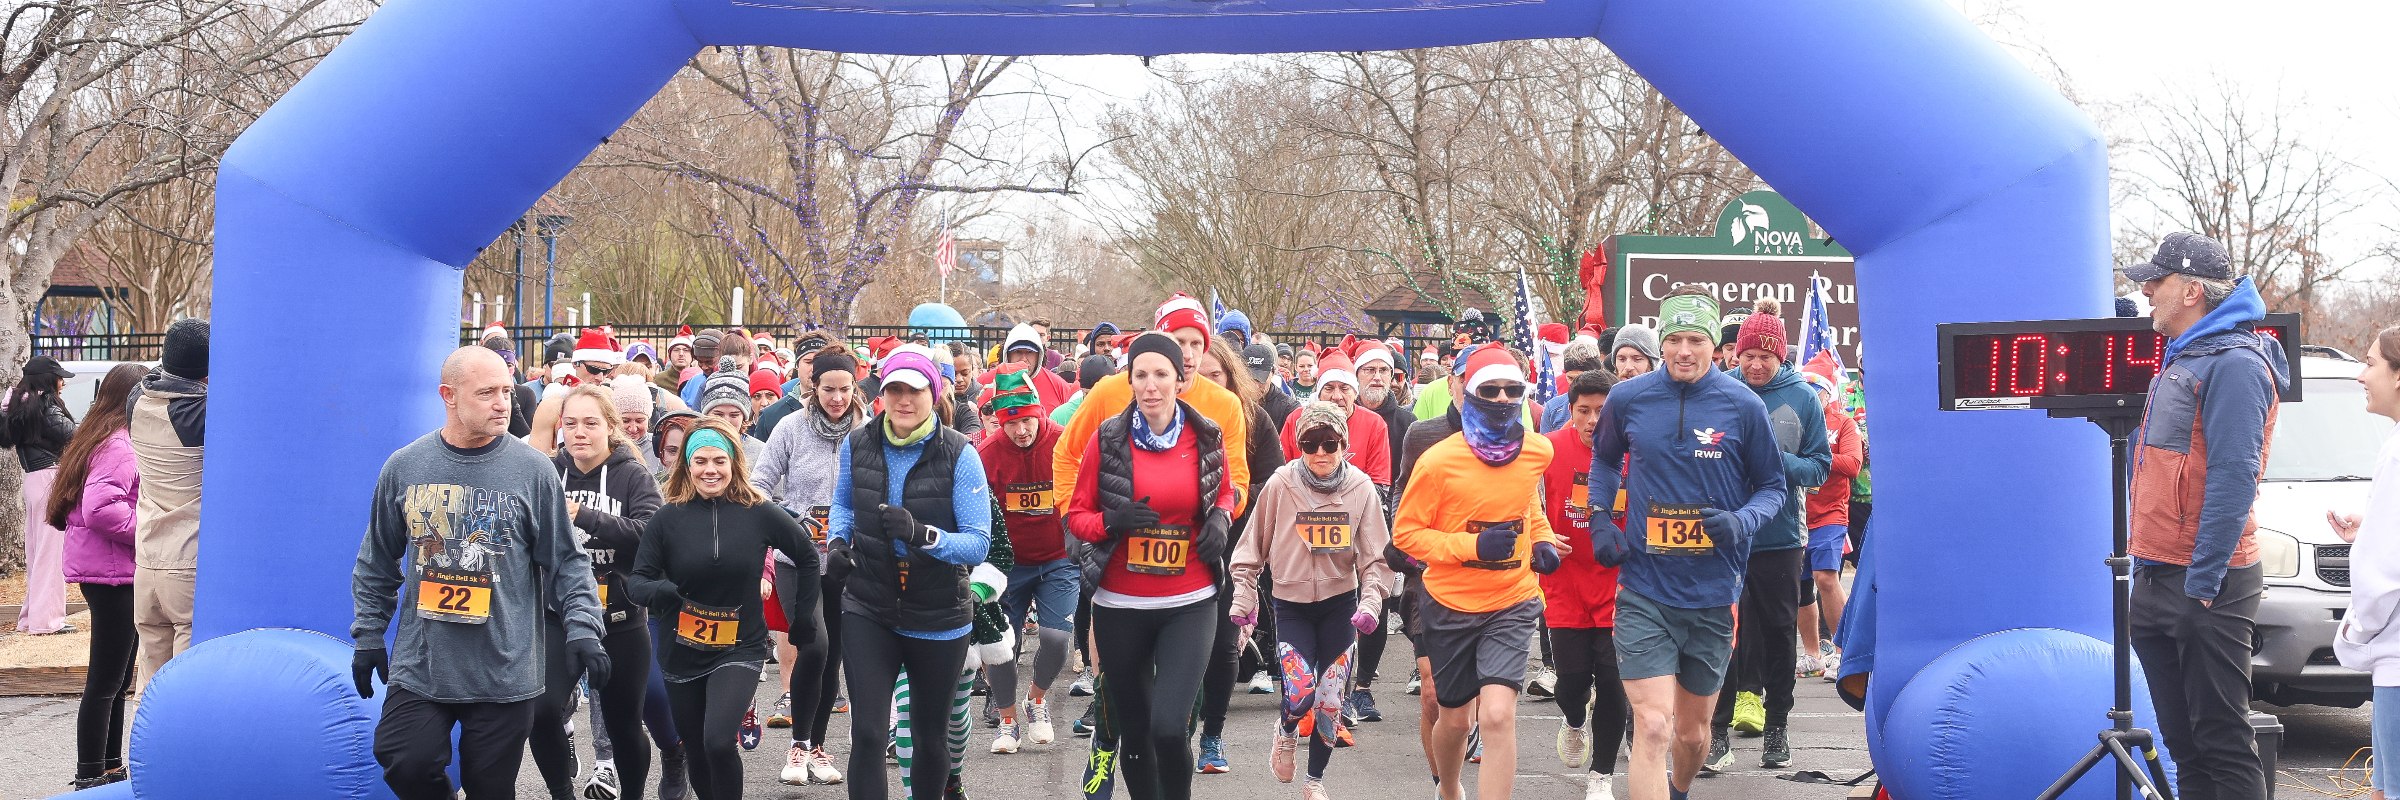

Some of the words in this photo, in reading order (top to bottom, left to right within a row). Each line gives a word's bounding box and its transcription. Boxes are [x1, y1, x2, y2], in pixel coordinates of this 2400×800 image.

[1755, 231, 1803, 246] NOVA
[1755, 246, 1804, 255] PARKS
[1694, 449, 1723, 459] RWB
[404, 483, 519, 523] AMERICA'S
[1020, 492, 1041, 508] 80
[1661, 508, 1678, 516] Jingle
[1304, 526, 1342, 545] 116
[1658, 520, 1704, 545] 134
[1140, 540, 1181, 564] 100
[437, 572, 455, 581] Jingle
[455, 574, 469, 582] Bell
[438, 586, 472, 612] 22
[693, 619, 719, 642] 21
